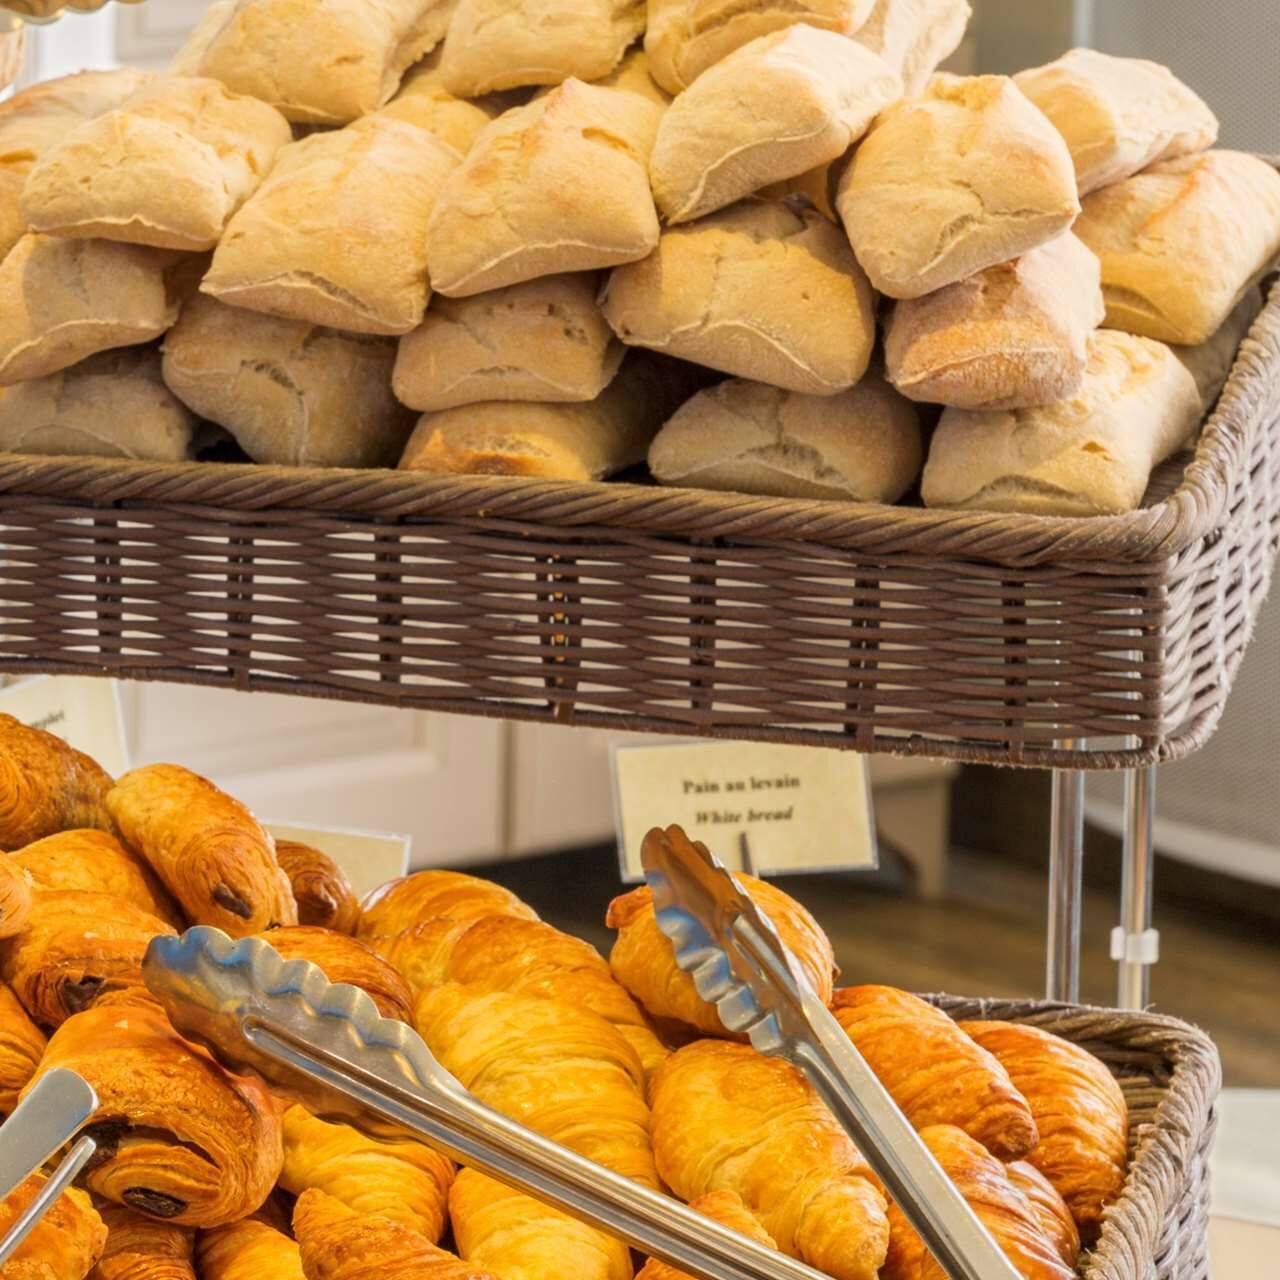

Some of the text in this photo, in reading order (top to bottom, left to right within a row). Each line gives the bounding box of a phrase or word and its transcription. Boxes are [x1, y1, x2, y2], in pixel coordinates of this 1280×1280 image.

[682, 775, 801, 796] Pain au levain
[696, 806, 793, 825] White bread
